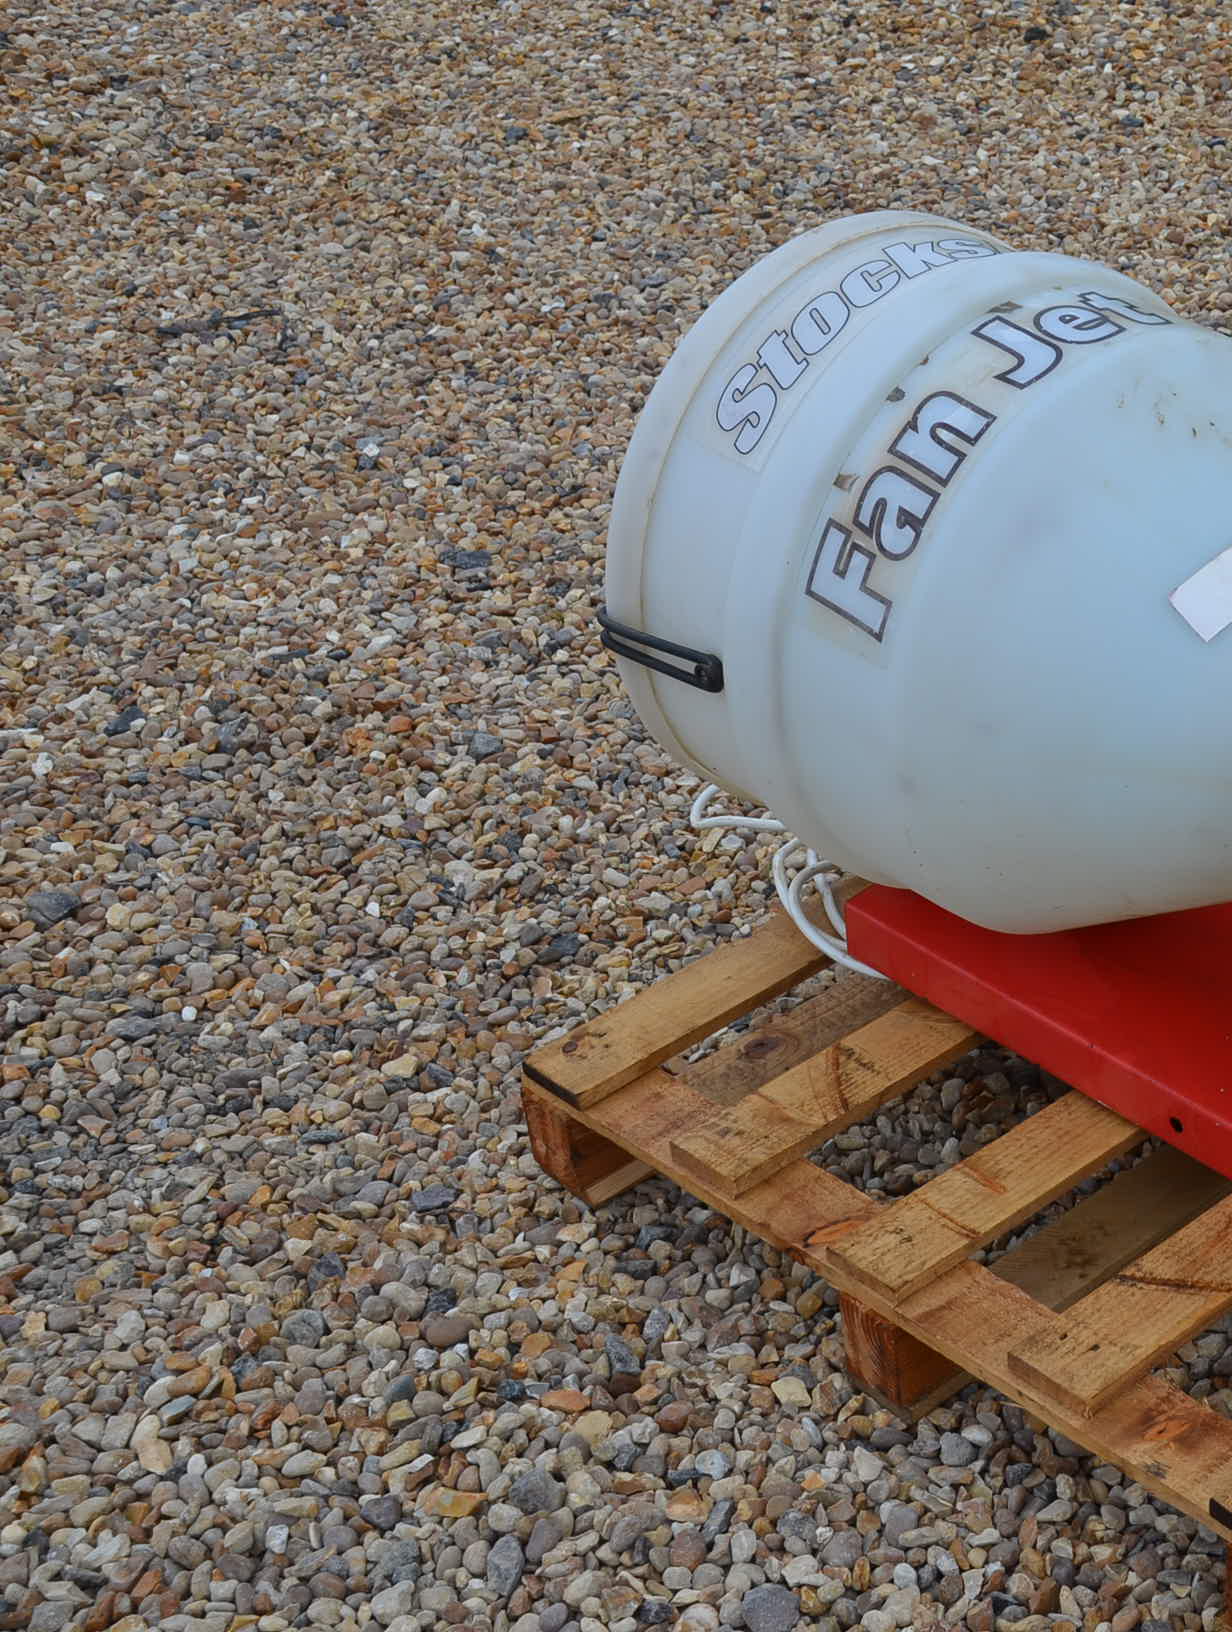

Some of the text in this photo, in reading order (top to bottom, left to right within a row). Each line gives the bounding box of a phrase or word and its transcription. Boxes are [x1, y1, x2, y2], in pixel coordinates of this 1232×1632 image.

[716, 239, 999, 455] Stocks
[805, 291, 1173, 643] Fan Jet
